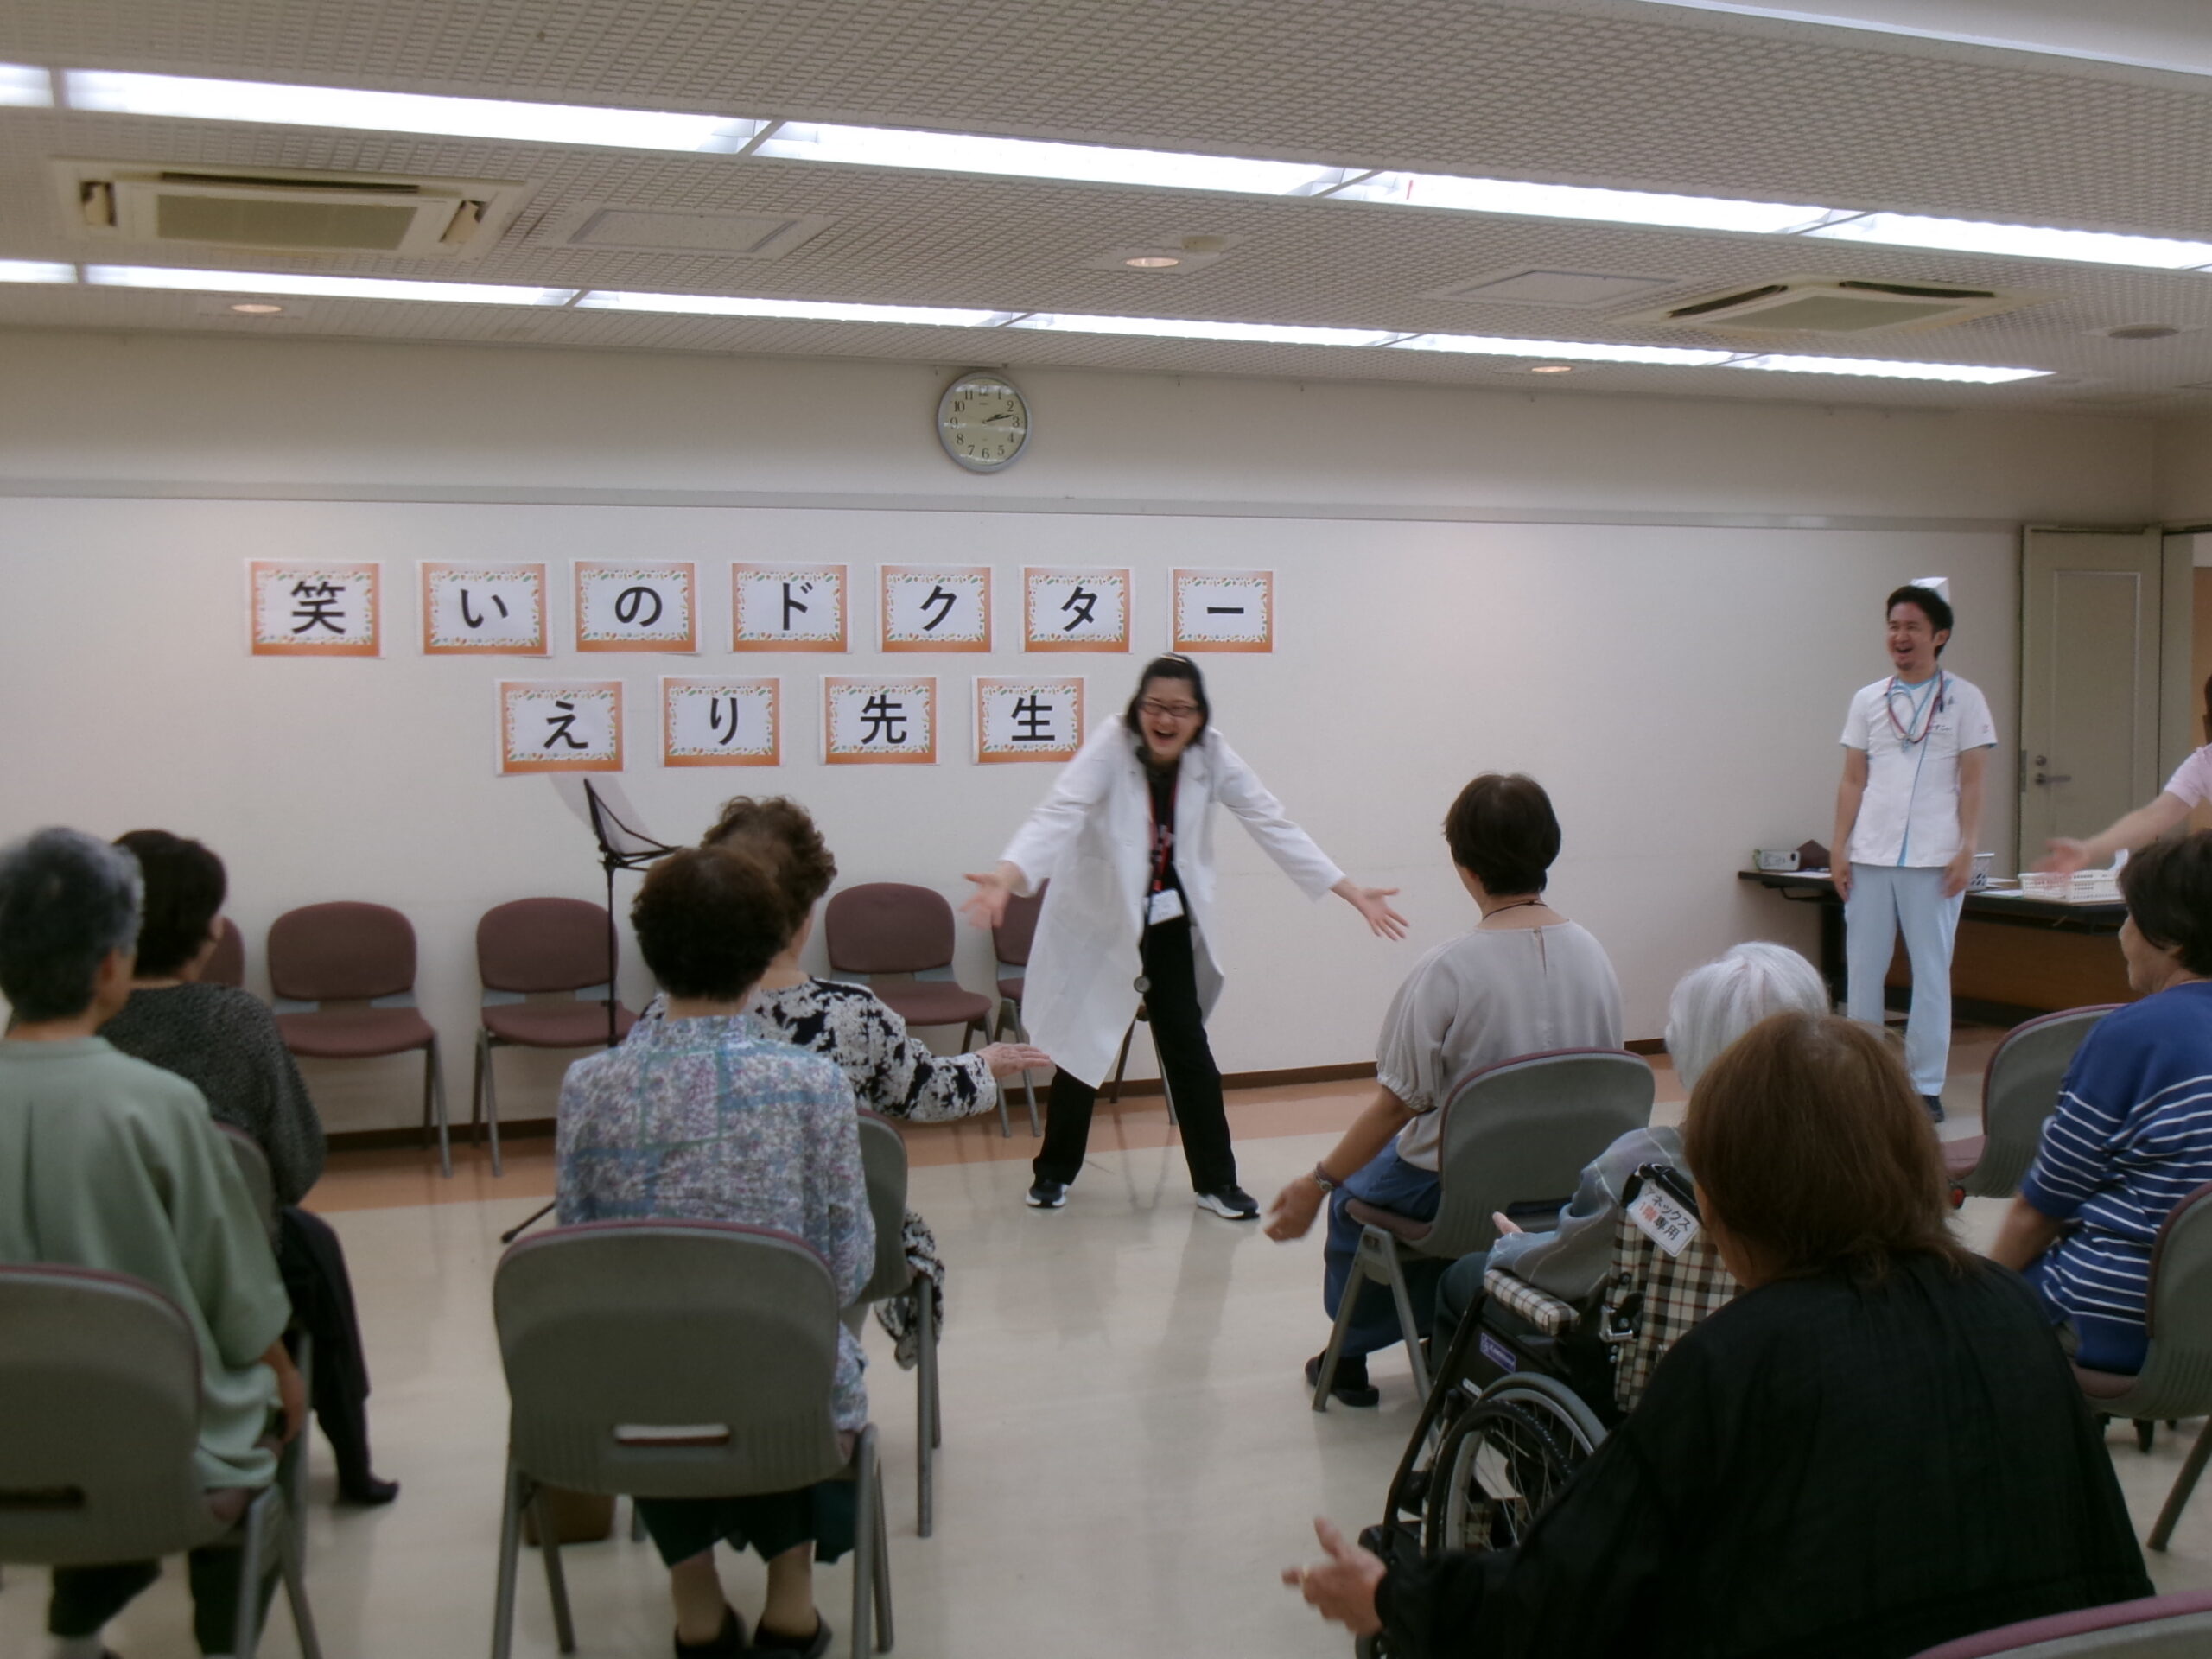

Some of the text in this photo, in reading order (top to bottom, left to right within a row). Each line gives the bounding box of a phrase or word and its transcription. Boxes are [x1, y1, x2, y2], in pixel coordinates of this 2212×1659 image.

[964, 389, 974, 400] 11
[954, 400, 965, 412] 10
[1007, 400, 1014, 412] 2
[950, 416, 958, 429] 9
[1012, 416, 1020, 429] 3
[956, 434, 964, 445] 8
[1007, 432, 1014, 443] 4
[968, 445, 976, 456] 7
[982, 448, 990, 460] 6
[997, 445, 1005, 456] 5
[543, 694, 1055, 749] えり先生
